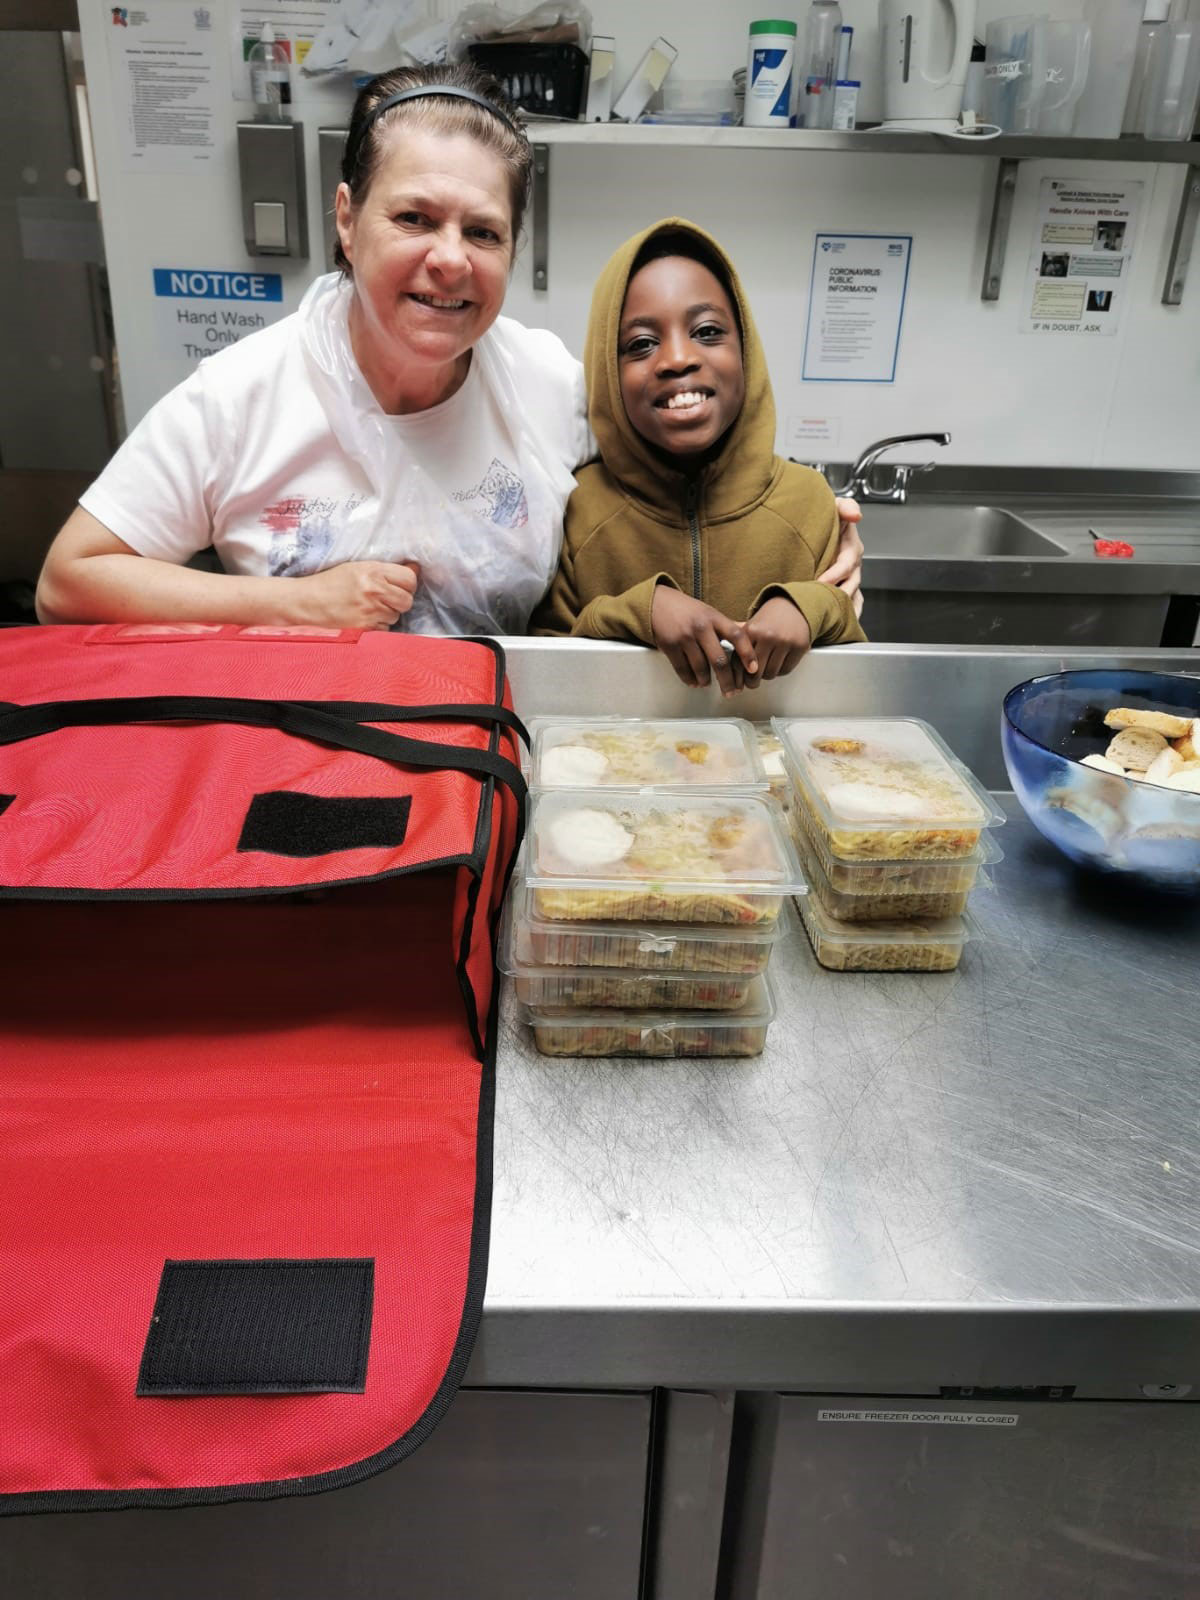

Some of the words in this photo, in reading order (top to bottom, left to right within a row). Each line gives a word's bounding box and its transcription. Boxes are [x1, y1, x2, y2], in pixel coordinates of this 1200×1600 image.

[998, 64, 1017, 73] ONLY
[829, 276, 853, 284] PUBLIC
[170, 272, 266, 298] NOTICE
[828, 285, 877, 293] INFORMATION
[177, 310, 217, 325] Hand
[221, 312, 265, 326] Wash
[1051, 324, 1081, 332] DOUBT,
[822, 1412, 861, 1420] ENSURE
[864, 1413, 909, 1421] FREEZER
[975, 1416, 1015, 1424] CLOSED
